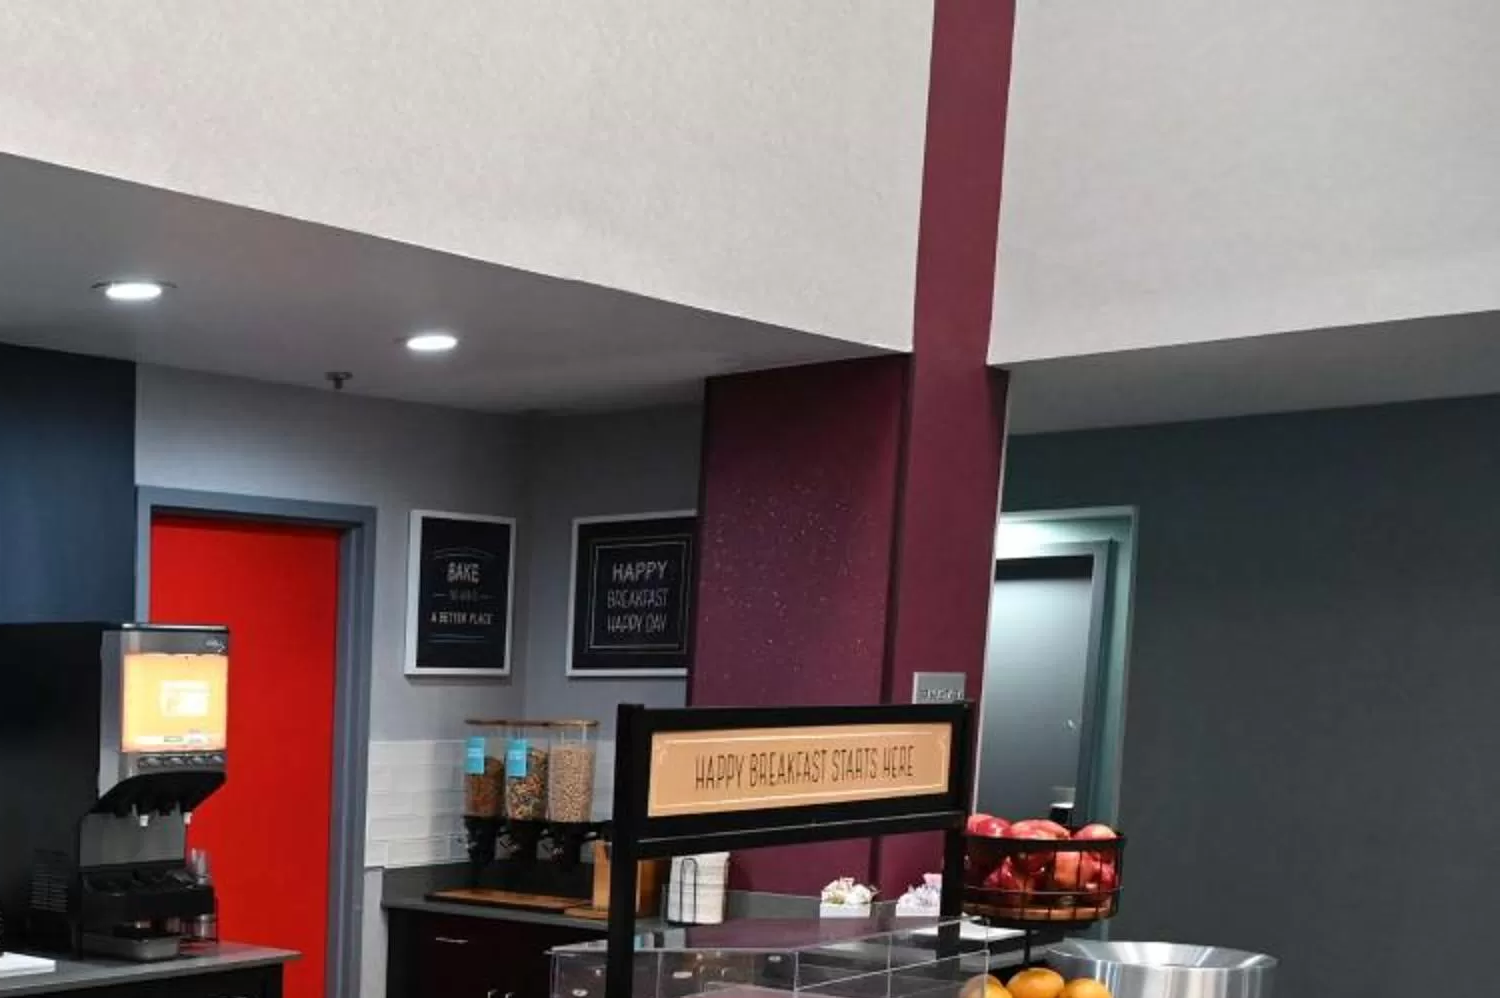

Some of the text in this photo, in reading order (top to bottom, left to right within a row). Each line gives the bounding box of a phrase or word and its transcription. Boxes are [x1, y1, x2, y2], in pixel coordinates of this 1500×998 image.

[446, 561, 480, 584] BAKE
[611, 559, 669, 582] HAPPY
[607, 588, 669, 609] BREAKFAST
[607, 612, 667, 633] HAPPY DAY
[694, 744, 915, 791] HAPPY BREAKFAST STARTS HERE
